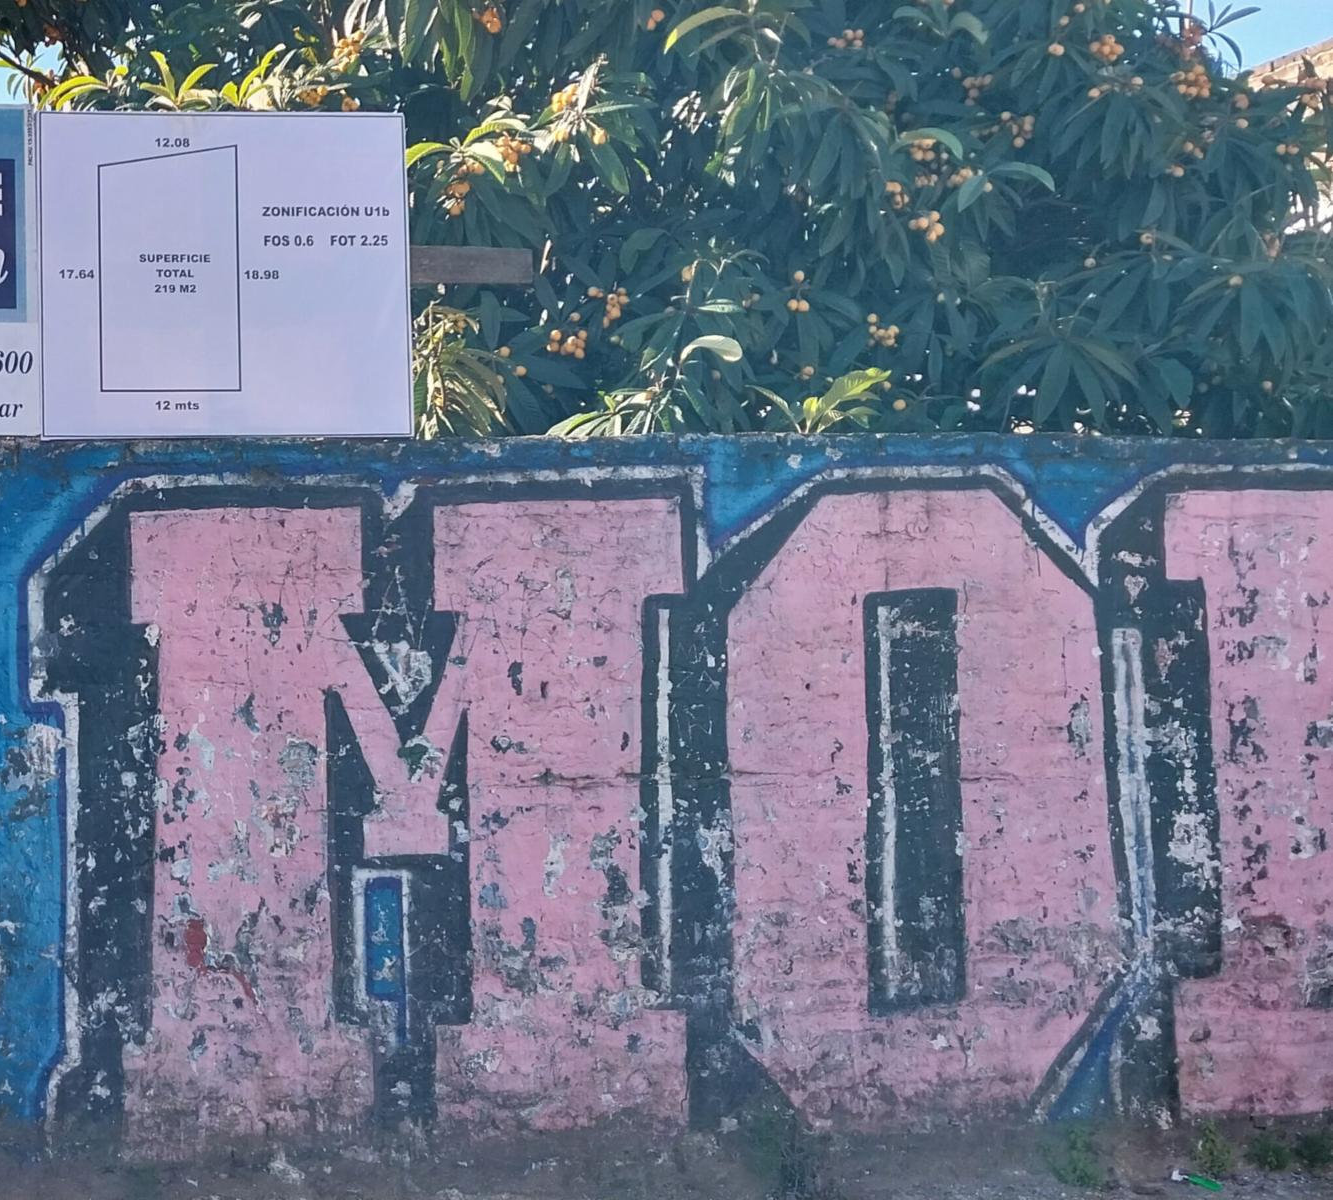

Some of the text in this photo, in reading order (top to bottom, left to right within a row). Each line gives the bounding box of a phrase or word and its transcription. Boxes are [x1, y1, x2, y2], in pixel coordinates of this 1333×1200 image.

[154, 137, 191, 148] 12.08
[262, 204, 390, 217] ZONIFICACIÓN U1b
[263, 234, 314, 247] FOS 0.6
[330, 234, 389, 247] FOT 2.25
[139, 253, 211, 263] SUPERFICIE
[58, 269, 95, 280] 17.64
[155, 268, 195, 278] TOTAL
[244, 269, 280, 280] 18.98
[154, 284, 197, 294] 219 M2
[155, 400, 200, 411] 12 mts
